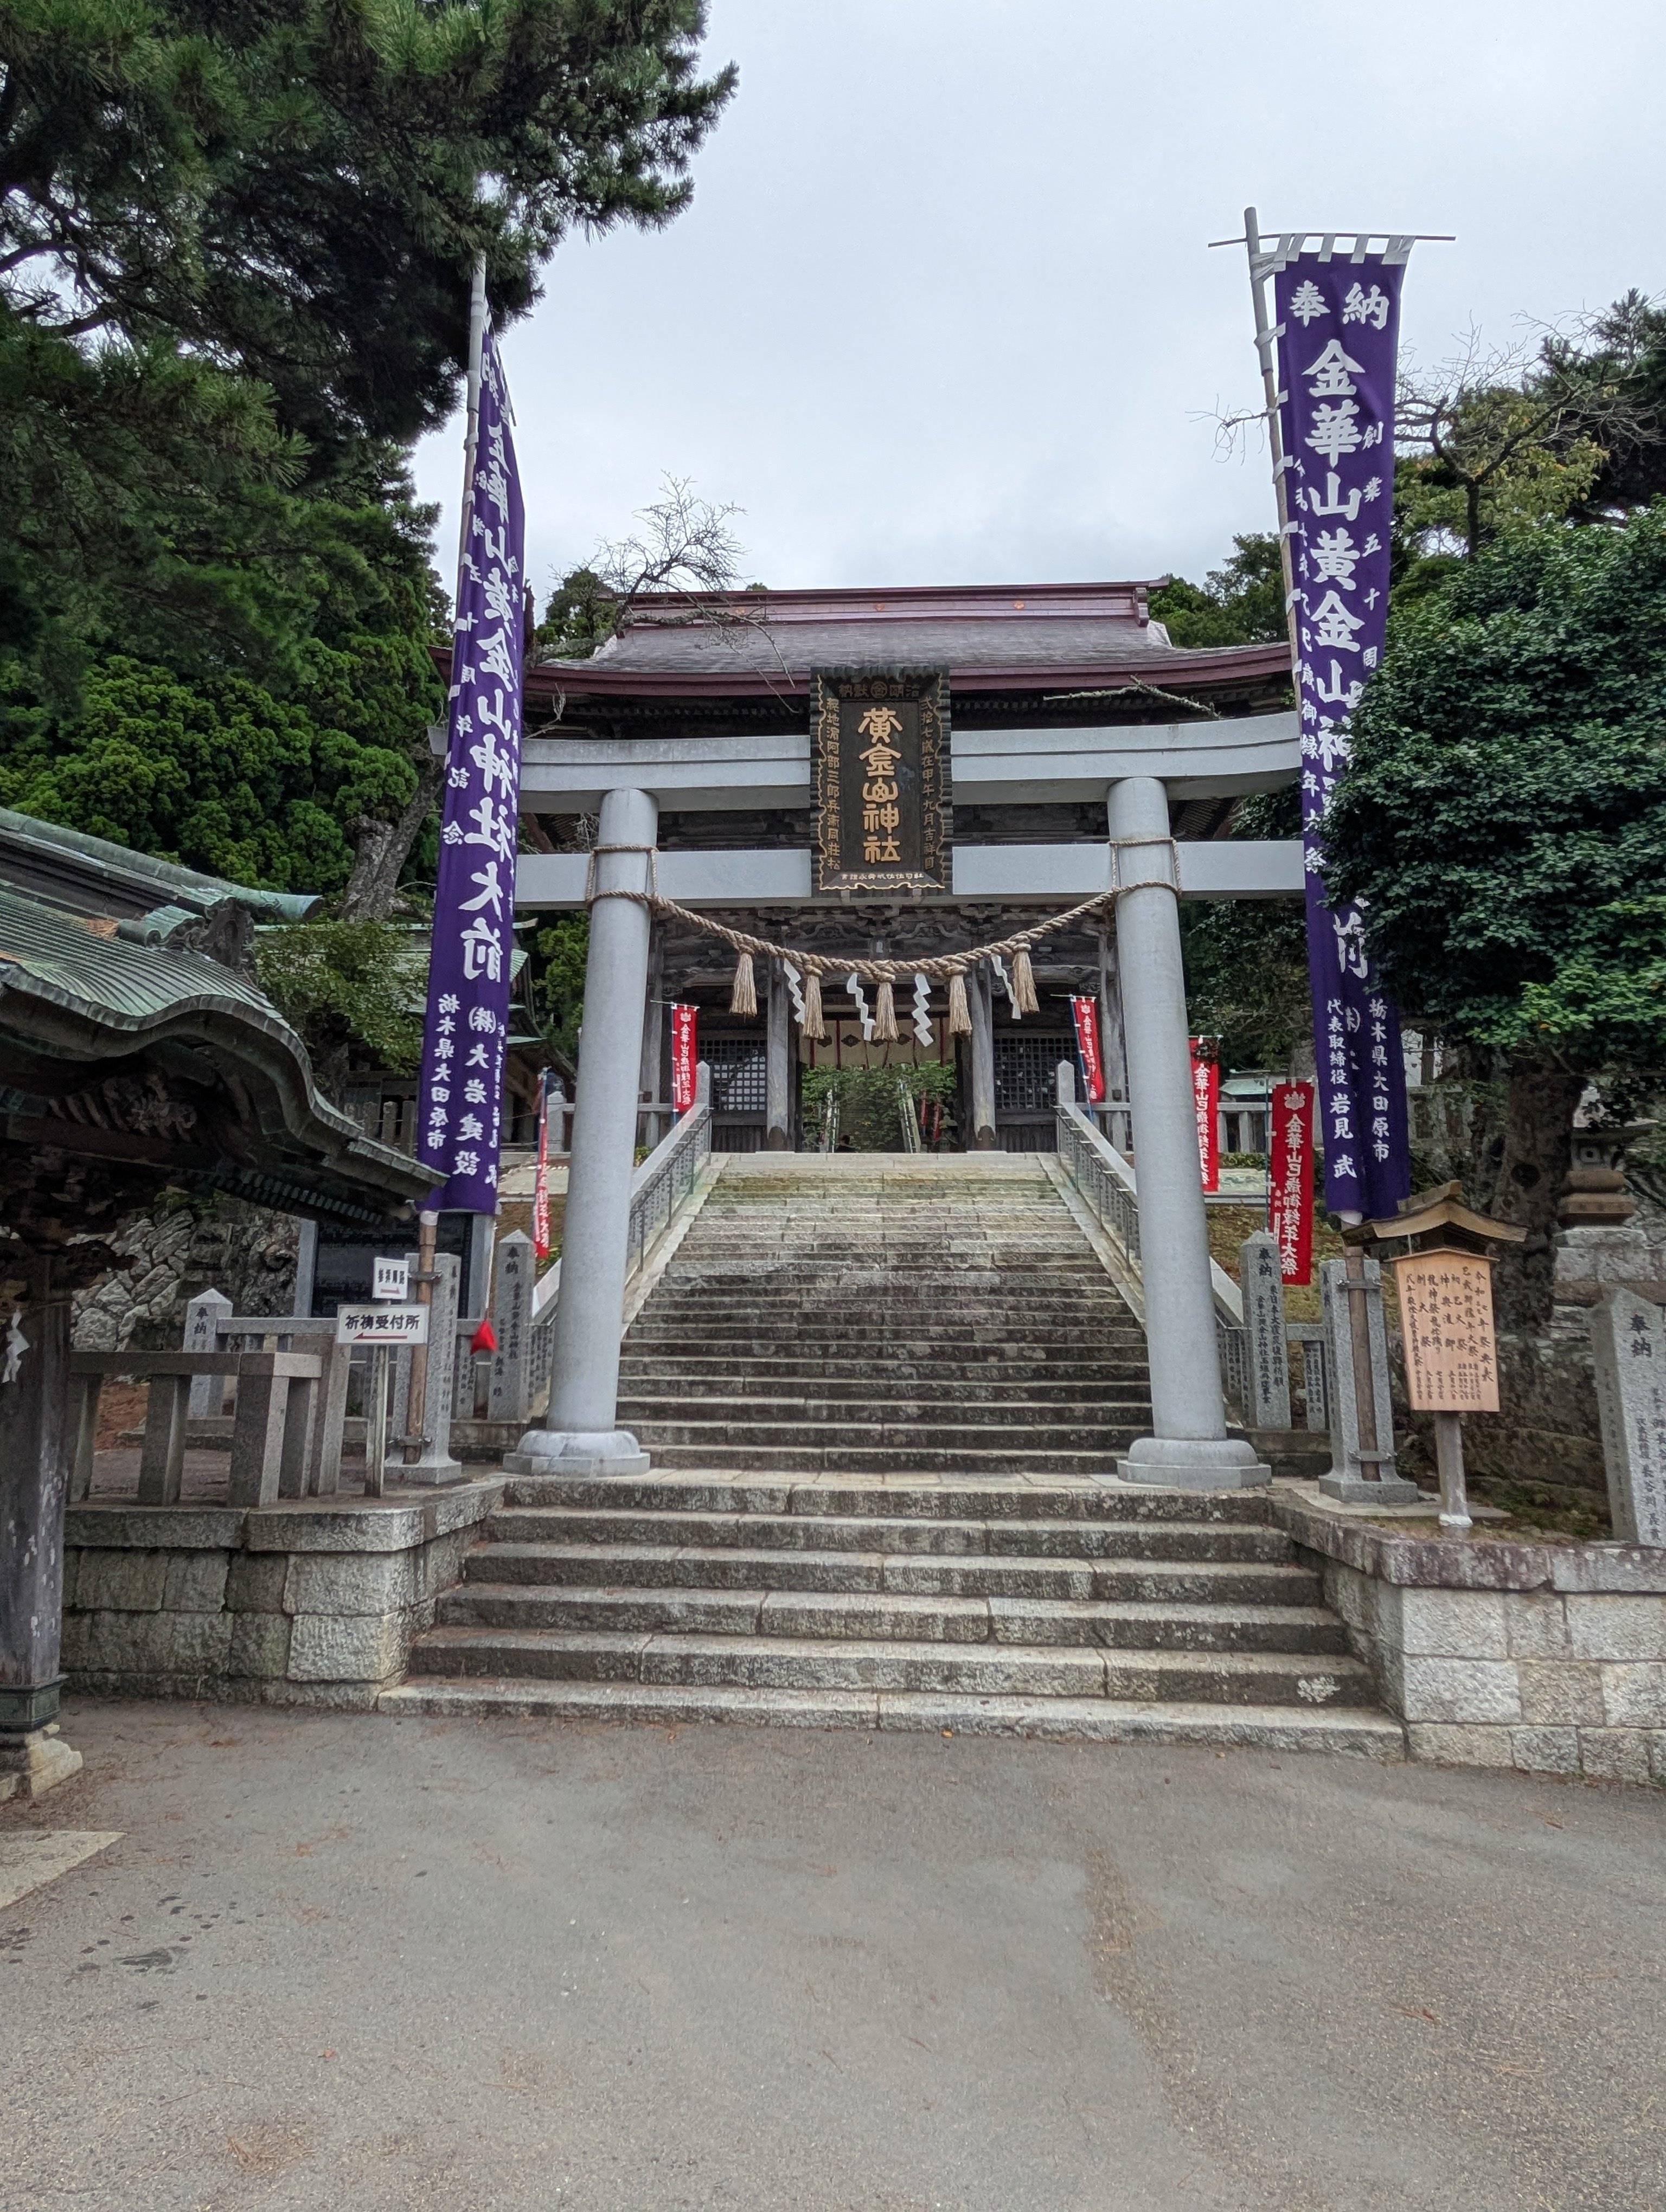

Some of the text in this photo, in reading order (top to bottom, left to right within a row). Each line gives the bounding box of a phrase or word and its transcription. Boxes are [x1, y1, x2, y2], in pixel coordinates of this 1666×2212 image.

[1290, 280, 1389, 330] 奉納
[1303, 338, 1370, 979] 金華山黄金山神前
[1369, 998, 1390, 1163] 栃木県大田原市
[1259, 1247, 1272, 1277] 奉納
[194, 1306, 209, 1335] 奉納
[1630, 1314, 1652, 1358] 奉納
